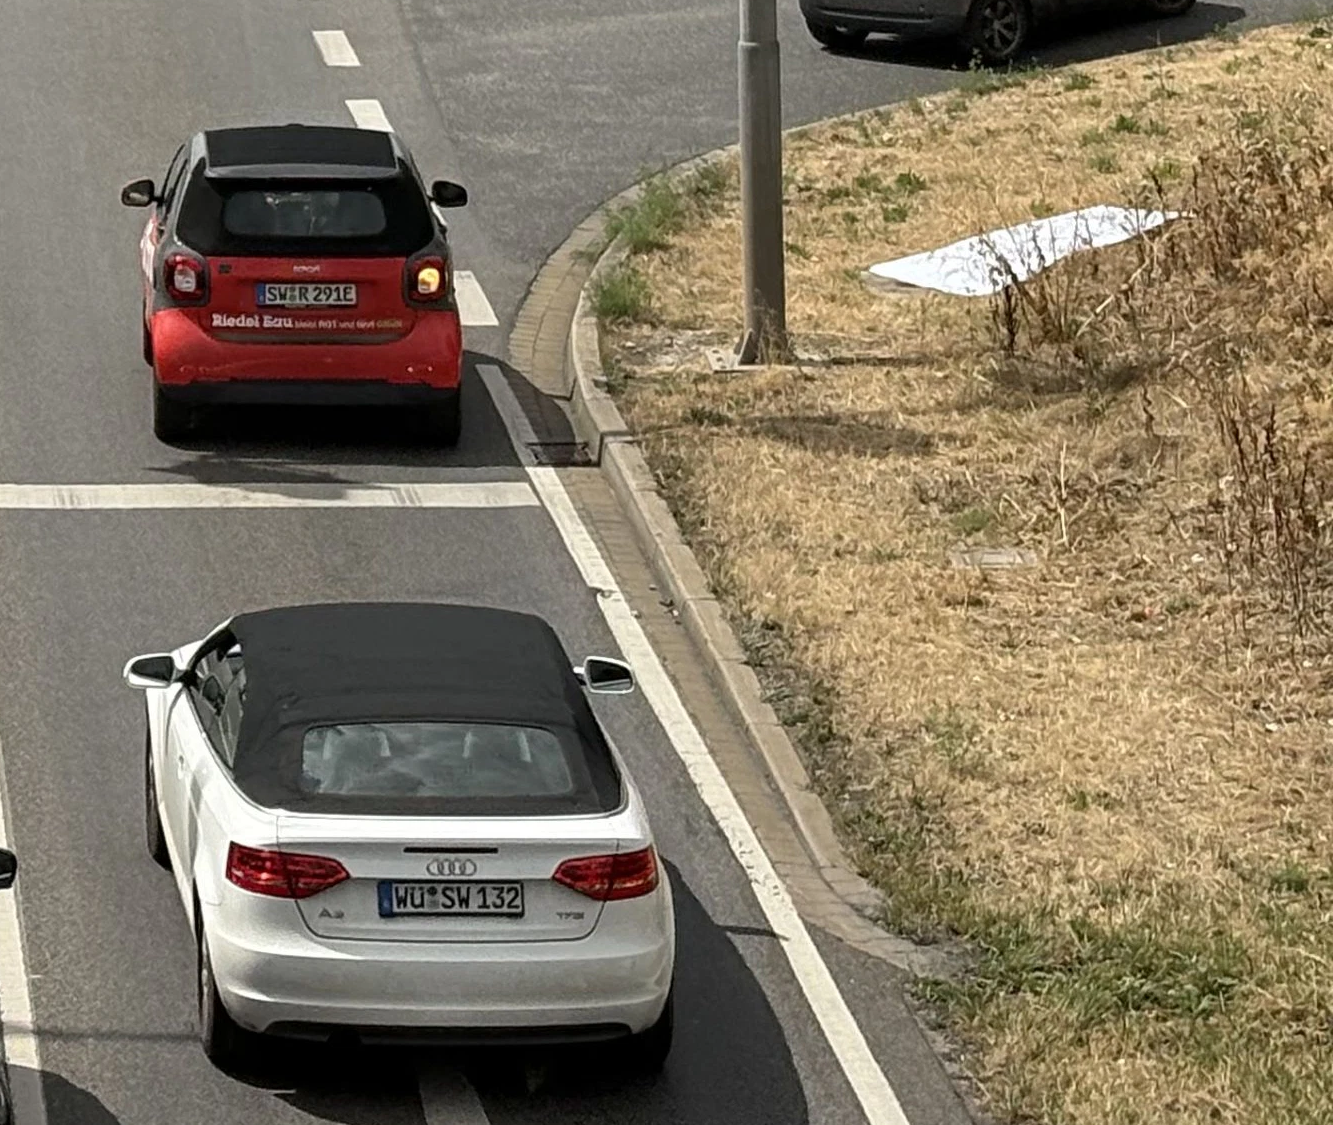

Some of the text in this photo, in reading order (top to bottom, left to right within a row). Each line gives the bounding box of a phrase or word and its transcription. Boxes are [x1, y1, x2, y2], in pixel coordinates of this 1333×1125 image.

[267, 286, 354, 302] SW R 291E
[212, 313, 260, 328] Riedel
[395, 886, 521, 909] WÜ SW 132
